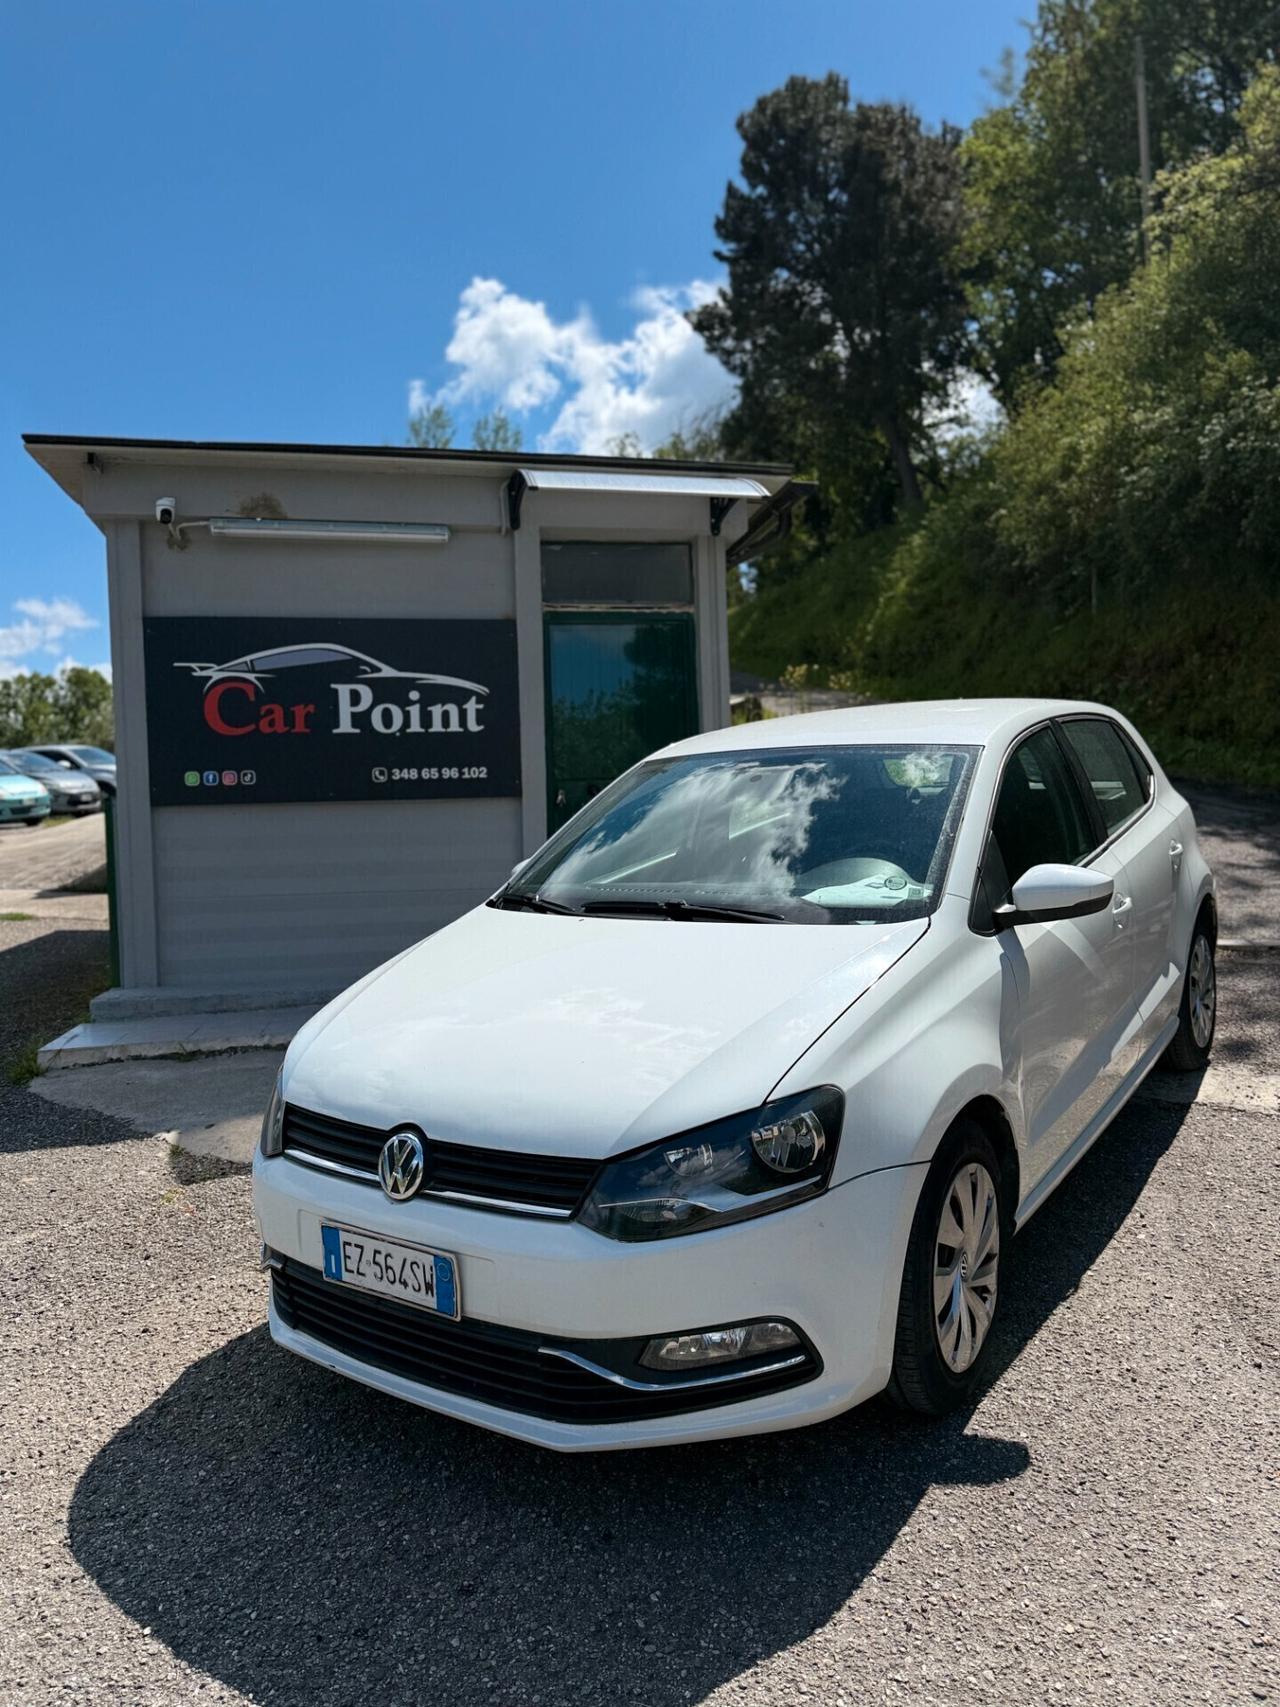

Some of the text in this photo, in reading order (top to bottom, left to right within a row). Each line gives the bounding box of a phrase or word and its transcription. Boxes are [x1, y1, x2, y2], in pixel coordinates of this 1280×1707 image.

[204, 681, 485, 735] Car Point
[391, 766, 488, 780] 348 65 96 102
